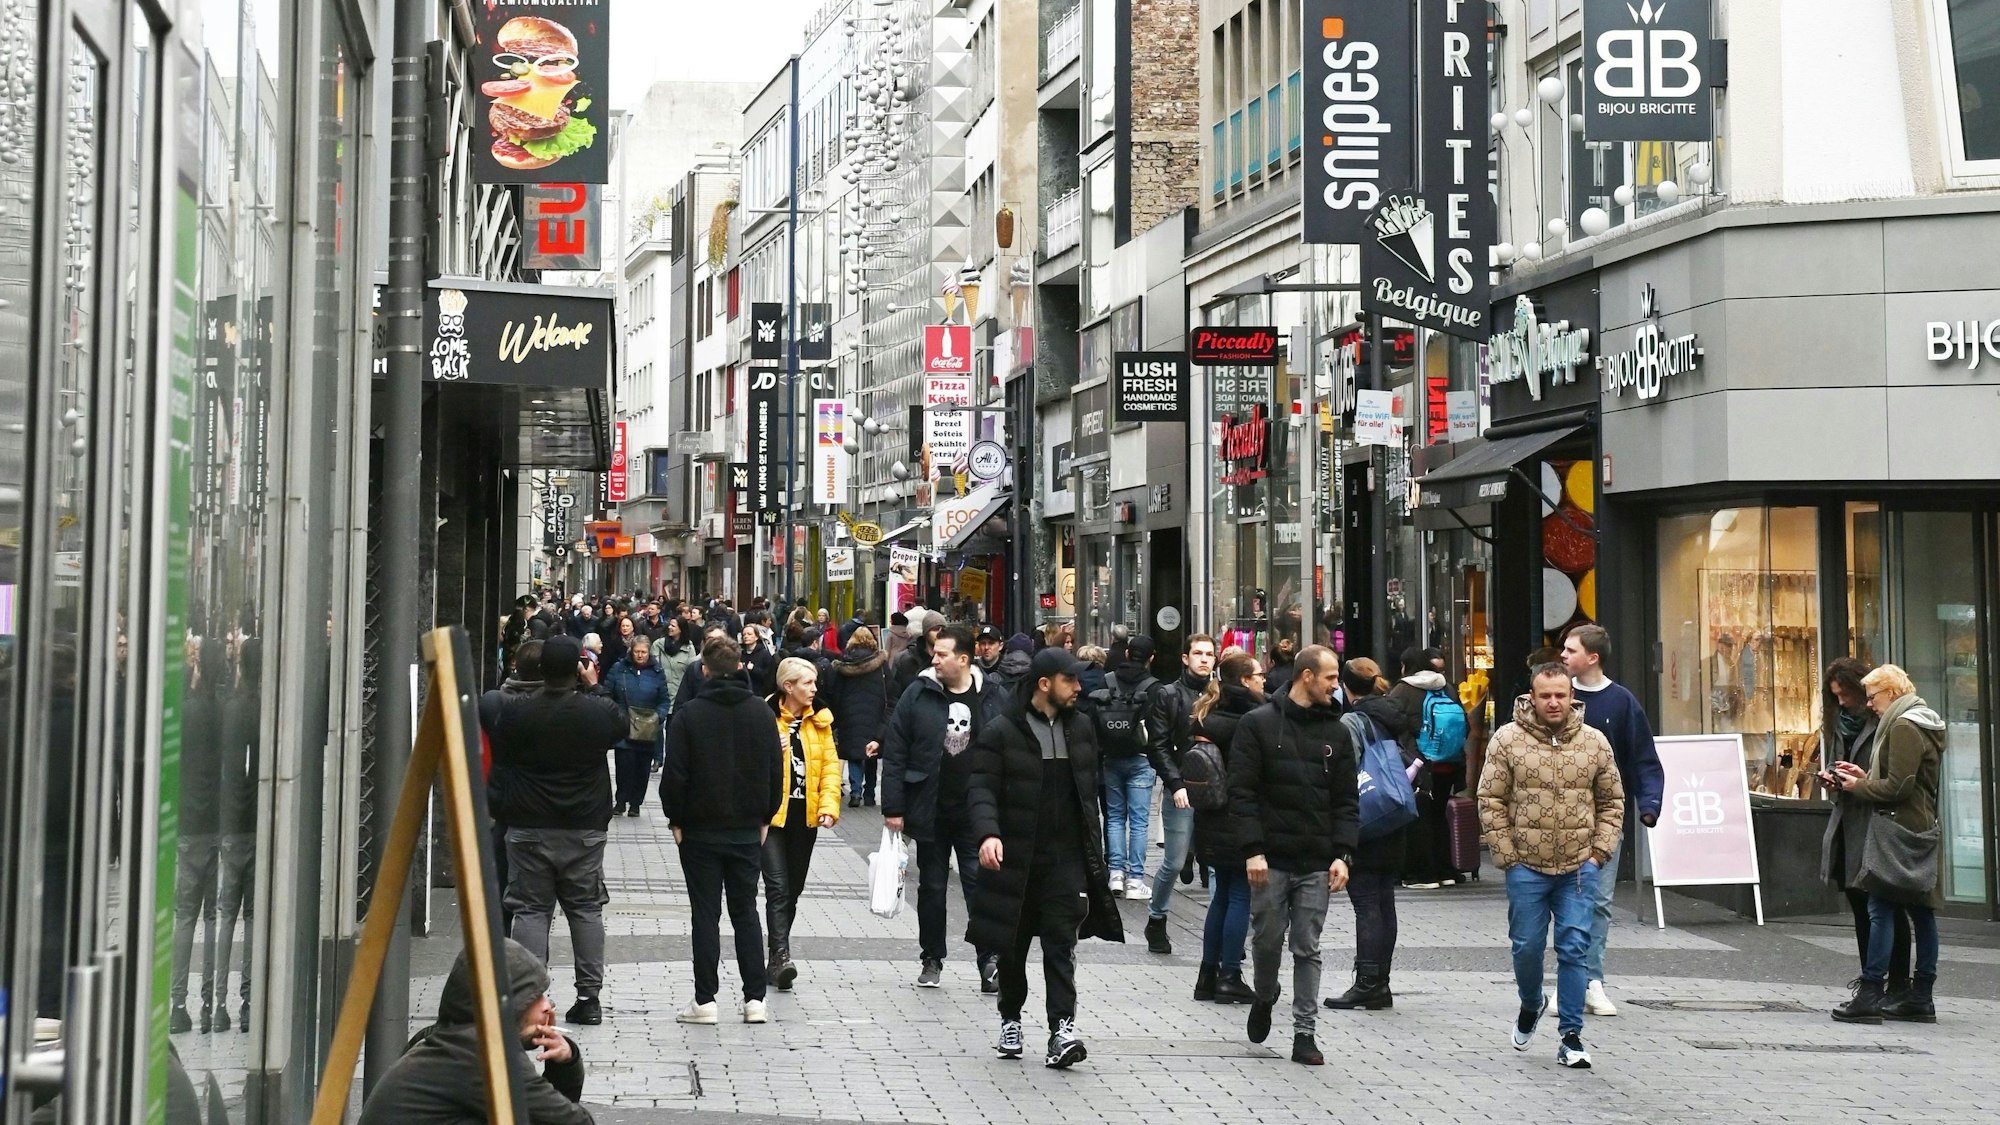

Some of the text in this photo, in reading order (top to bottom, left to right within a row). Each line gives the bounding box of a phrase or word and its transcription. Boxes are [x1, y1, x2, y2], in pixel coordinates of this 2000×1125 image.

[1598, 103, 1697, 117] BIJOU BRIGITTE
[1322, 41, 1391, 210] snipes
[1373, 277, 1482, 328] Belgique
[498, 312, 593, 364] Welcome
[1197, 332, 1276, 354] Piccadly
[432, 355, 470, 380] BACK
[1122, 362, 1177, 378] LUSH
[1608, 350, 1636, 397] BIJOU
[751, 372, 777, 390] JD
[930, 380, 966, 391] Pizza
[1122, 379, 1177, 392] FRESH
[928, 394, 968, 406] König
[1123, 393, 1177, 402] HANDMADE
[1123, 402, 1177, 412] COSMETICS
[1358, 411, 1390, 420] Free WiFi
[758, 401, 768, 454] TRAINERS
[1357, 419, 1384, 428] für alle!
[929, 441, 967, 449] gekühlte
[758, 466, 767, 492] KING
[826, 454, 836, 499] DUNKIN'
[939, 524, 963, 540] LO
[891, 550, 918, 563] Crepes
[828, 568, 853, 578] Bratwurst
[1106, 720, 1130, 730] GOP.
